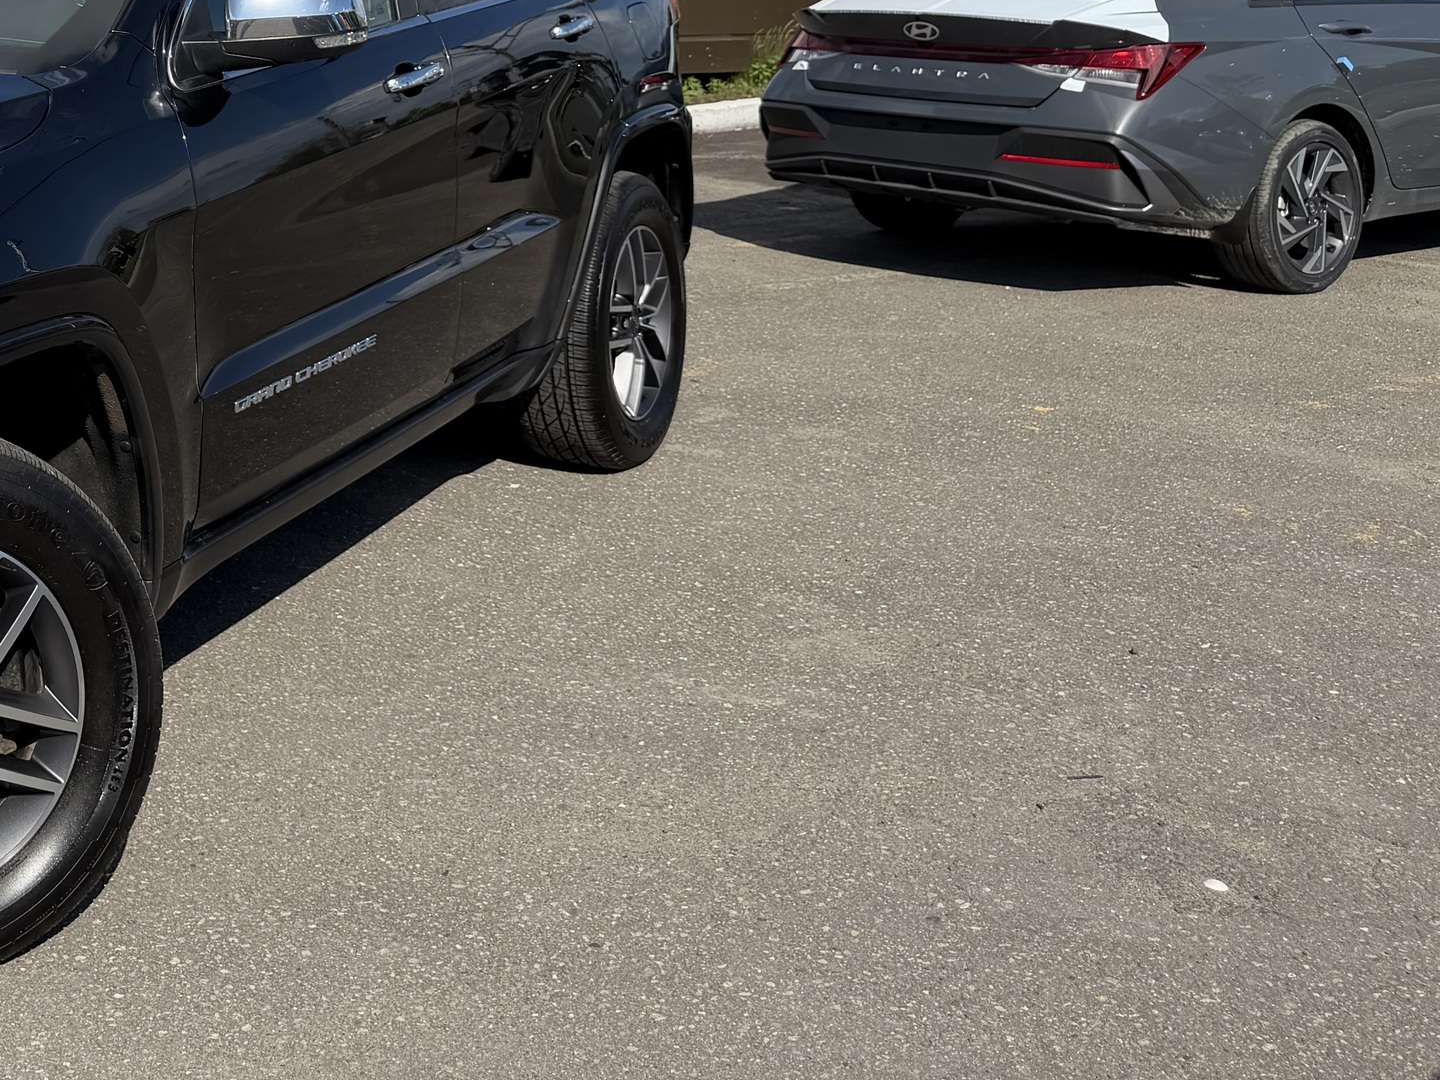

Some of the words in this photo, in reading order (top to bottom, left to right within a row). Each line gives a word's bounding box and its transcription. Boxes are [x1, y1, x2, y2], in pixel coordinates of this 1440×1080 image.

[853, 62, 990, 80] ELANTRA
[234, 375, 293, 414] GRAND
[295, 333, 378, 384] CHEROKEE
